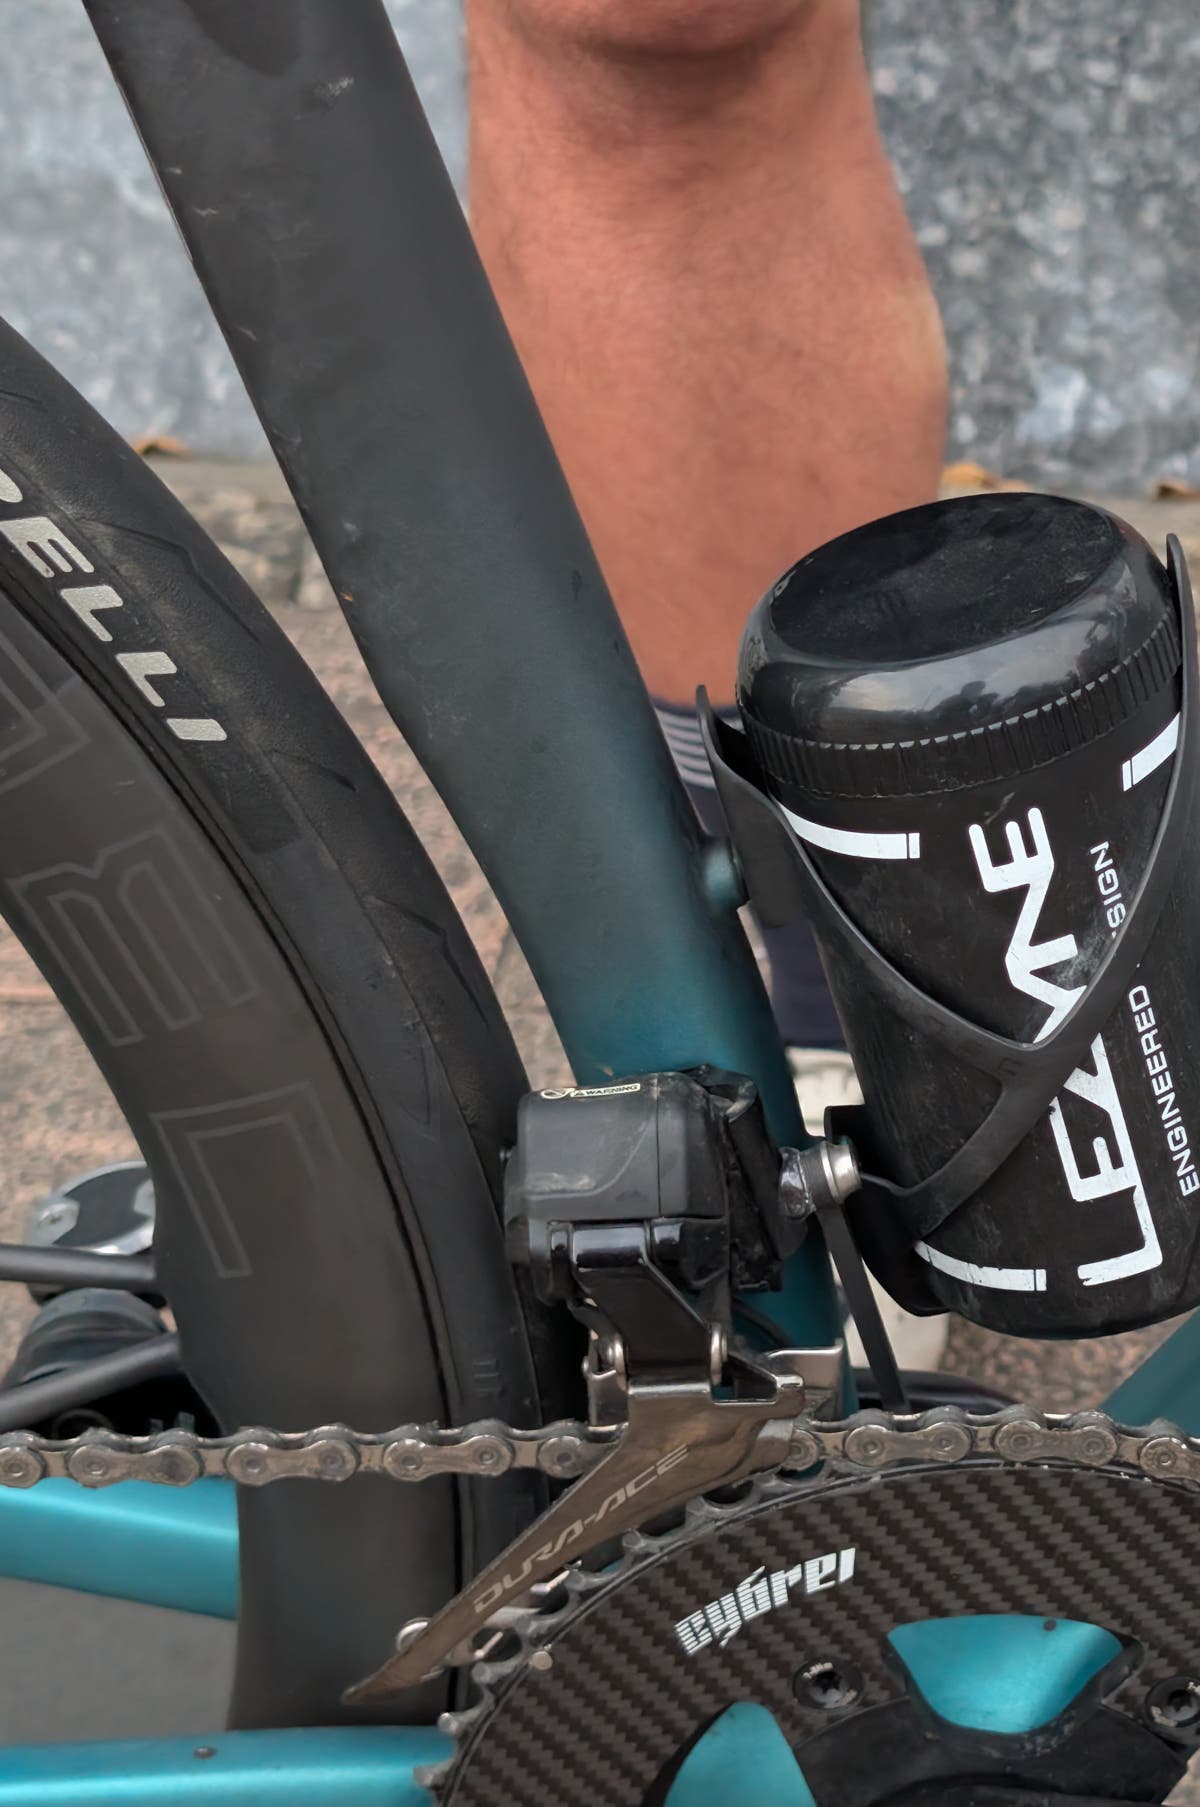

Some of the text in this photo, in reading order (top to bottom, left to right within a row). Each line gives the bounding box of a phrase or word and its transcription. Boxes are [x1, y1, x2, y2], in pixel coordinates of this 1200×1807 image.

[0, 468, 228, 741] ELLI
[1089, 841, 1200, 1197] ENGINEERED SIGN
[473, 1443, 689, 1614] DURA-ACE
